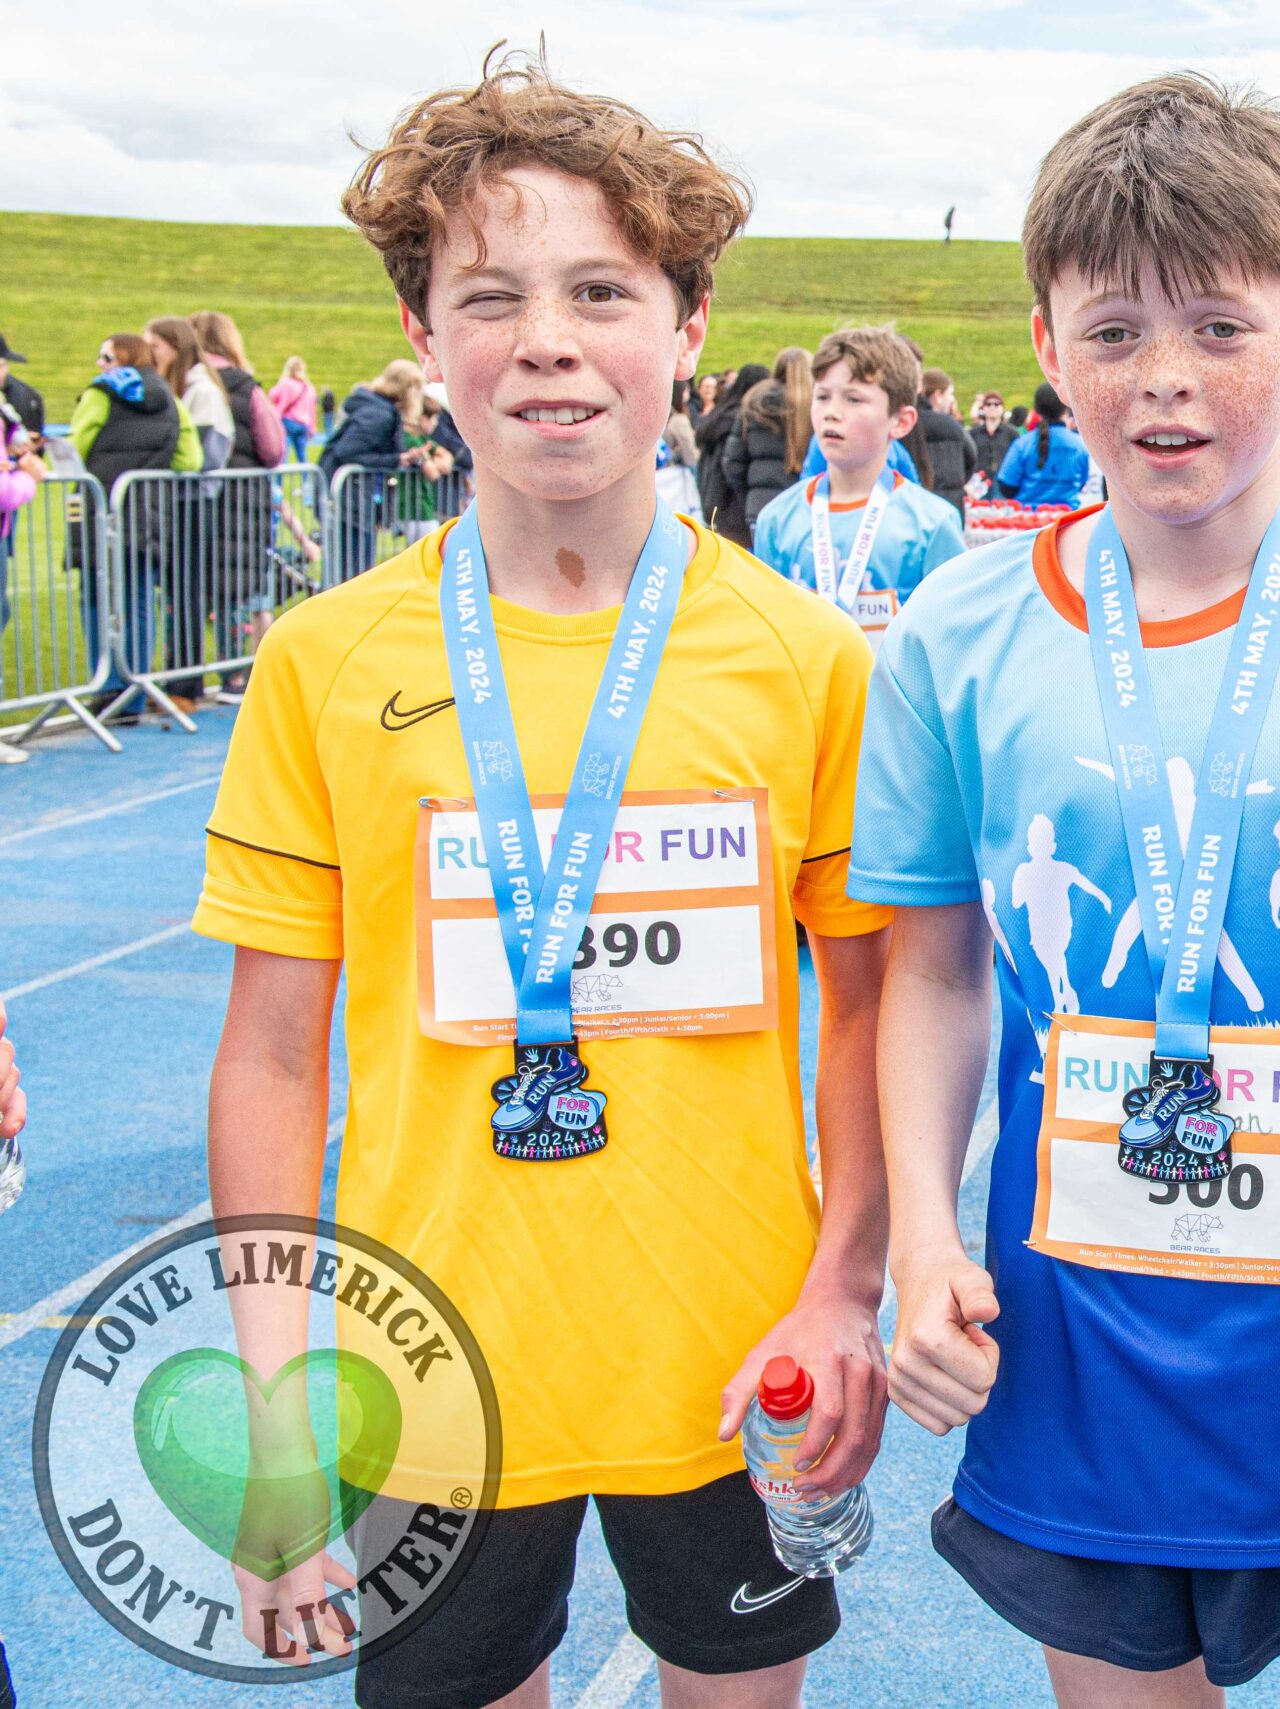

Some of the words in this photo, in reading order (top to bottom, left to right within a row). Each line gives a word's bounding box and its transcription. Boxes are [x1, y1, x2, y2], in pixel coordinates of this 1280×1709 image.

[856, 533, 871, 557] FOR
[865, 507, 879, 529] FUN
[455, 549, 473, 586] 4TH
[465, 647, 492, 704] 2024
[858, 604, 888, 616] FUN
[1099, 550, 1118, 588] 4TH
[1111, 650, 1138, 708] 2024
[607, 675, 636, 719] 4TH
[638, 564, 669, 614] 2024
[1231, 671, 1258, 716] 4TH
[437, 837, 489, 870] RU
[660, 826, 747, 861] FUN
[498, 818, 525, 870] RUN
[563, 831, 594, 878] FUN
[1142, 824, 1169, 877] RUN
[1197, 833, 1223, 882] FUN
[509, 876, 535, 923] FOR
[550, 884, 580, 930] FOR
[1187, 887, 1213, 936] FOR
[536, 934, 564, 984] RUN
[1176, 941, 1202, 993] RUN
[571, 1007, 592, 1015] EAR
[527, 1073, 558, 1104] RUN
[1065, 1057, 1149, 1094] RUN
[555, 1110, 588, 1126] FUN
[557, 1096, 590, 1112] FOR
[1157, 1090, 1189, 1122] RUN
[528, 1131, 575, 1147] 2024
[1181, 1131, 1215, 1151] FUN
[1185, 1116, 1218, 1136] FOR
[1151, 1151, 1199, 1167] 2024
[1079, 1248, 1094, 1256] Run
[1095, 1249, 1112, 1258] Start
[1138, 1255, 1202, 1267] Wheelchair/Walker
[1170, 1244, 1192, 1252] BEAR
[1194, 1245, 1221, 1254] RACES
[1100, 1262, 1164, 1275] First/Second/Third
[1201, 1272, 1265, 1282] Fourth/Fifth/Sixth
[753, 1474, 799, 1495] ishk
